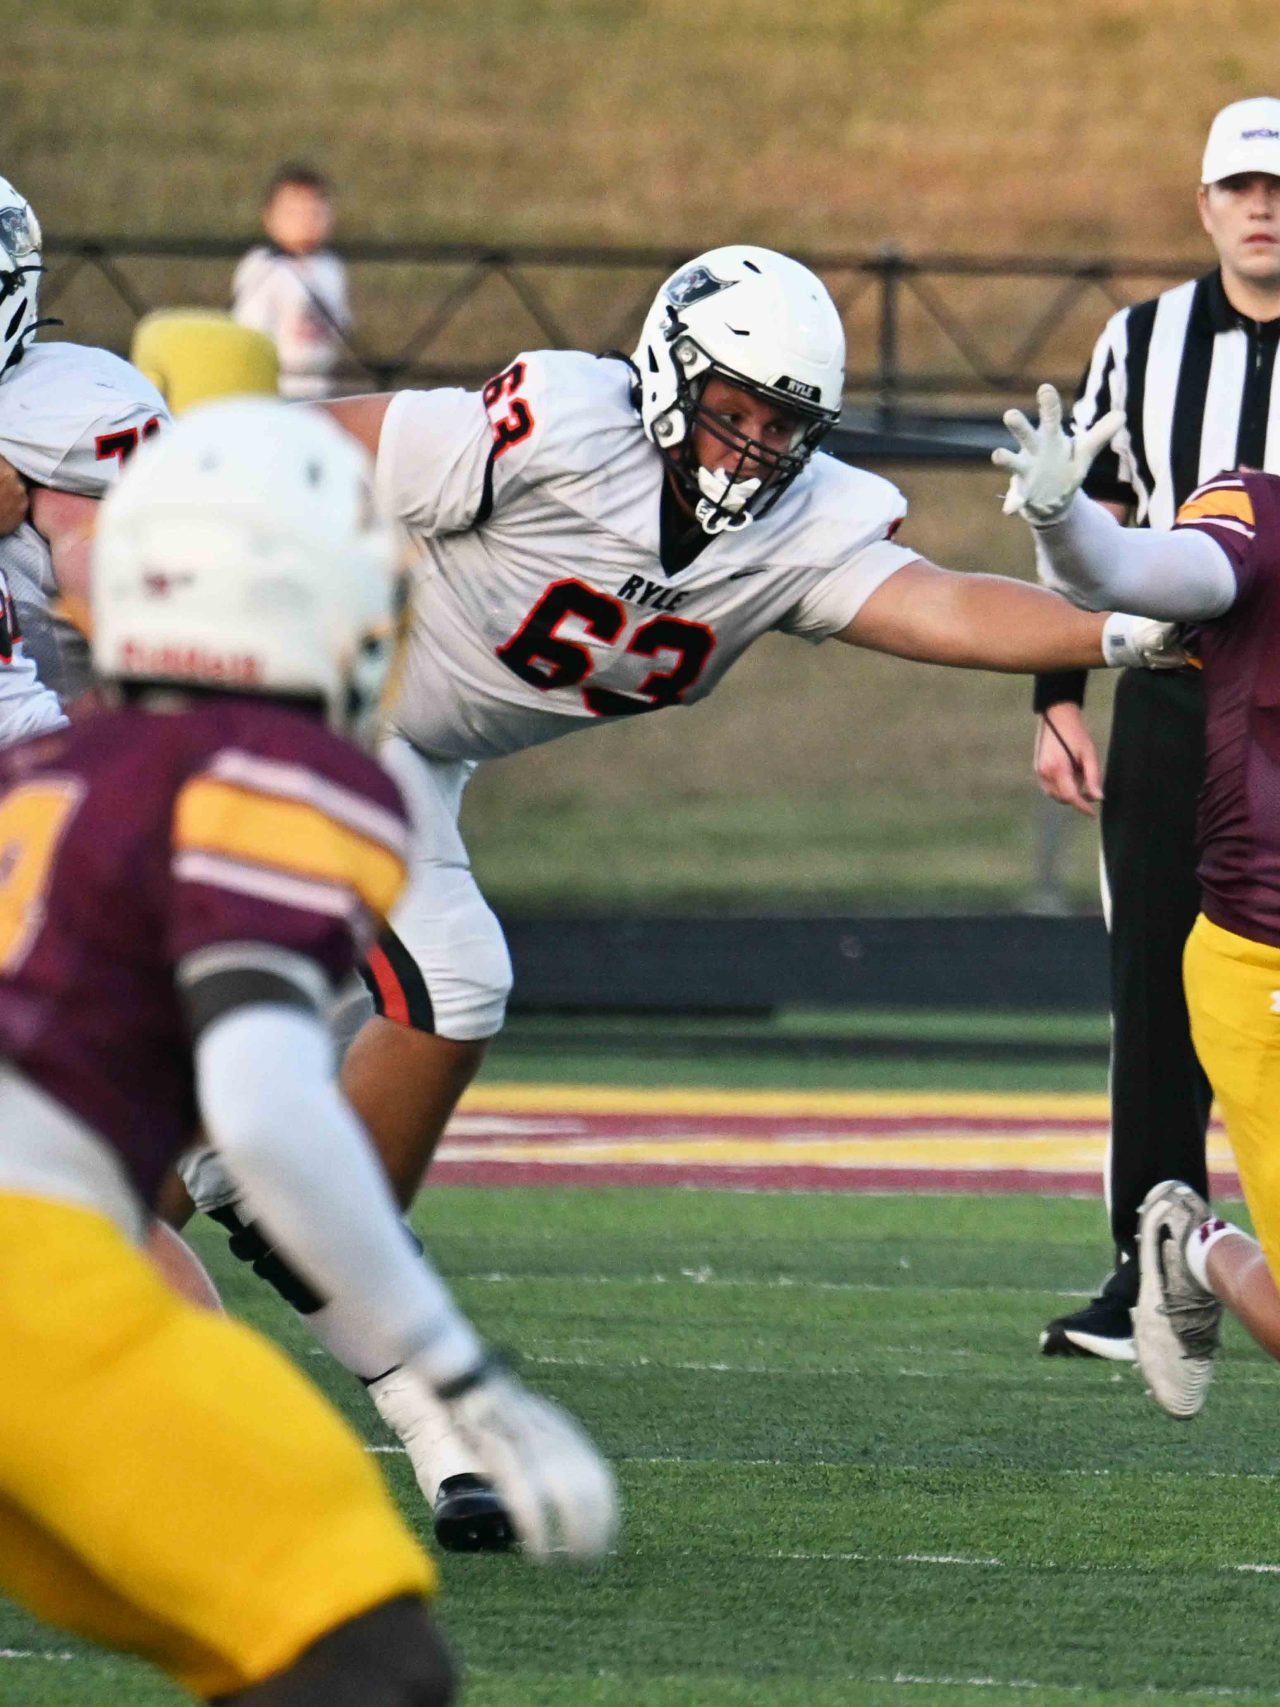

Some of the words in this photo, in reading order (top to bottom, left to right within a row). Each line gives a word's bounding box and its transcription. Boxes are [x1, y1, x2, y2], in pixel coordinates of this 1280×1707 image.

[95, 415, 161, 471] 7
[483, 361, 535, 461] 63
[617, 574, 690, 611] RYLE
[496, 577, 717, 716] 63
